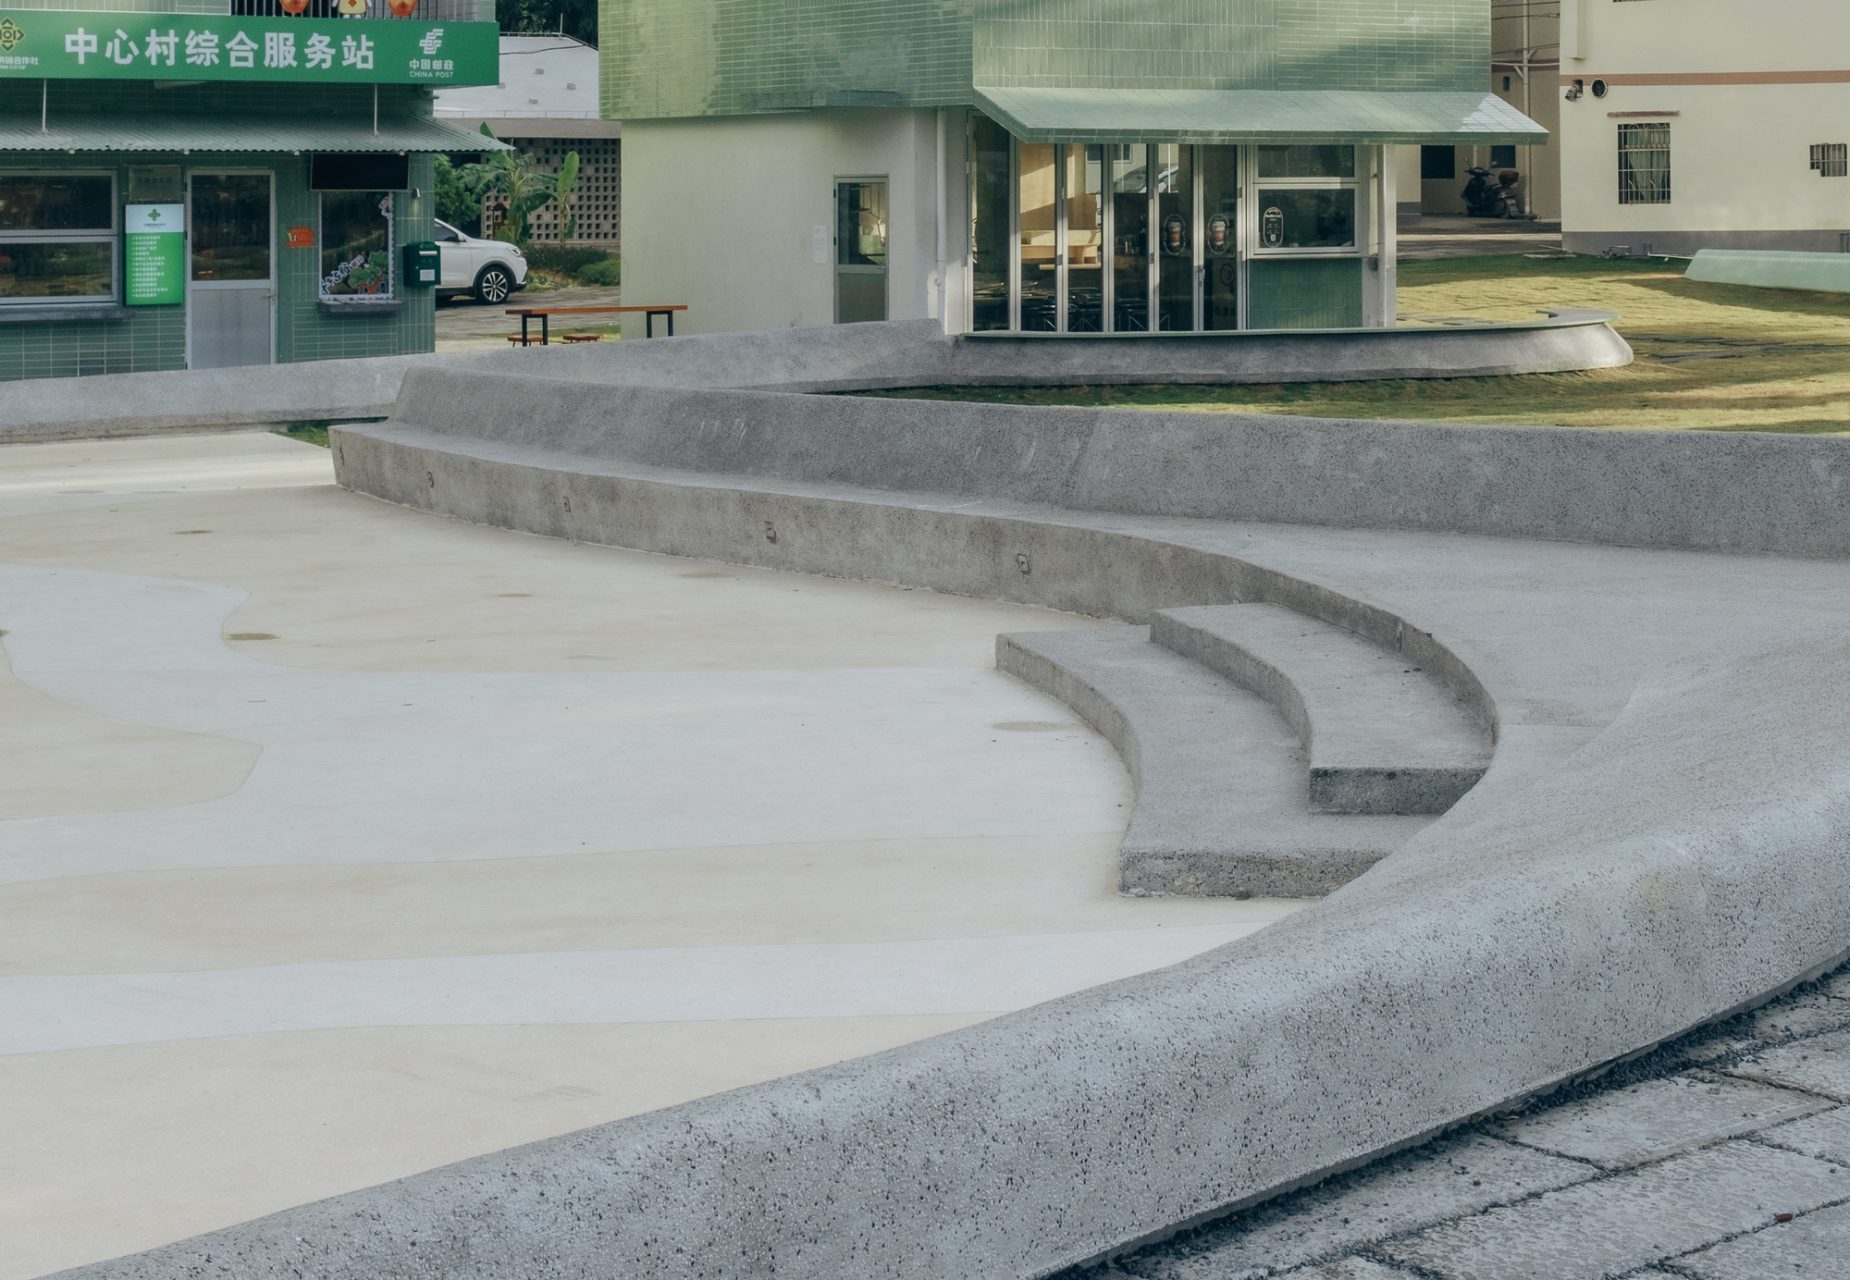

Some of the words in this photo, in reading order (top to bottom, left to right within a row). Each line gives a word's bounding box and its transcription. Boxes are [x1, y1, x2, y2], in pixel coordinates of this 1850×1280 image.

[65, 27, 375, 70] 中心村综合服务站
[409, 58, 454, 70] 中国邮政
